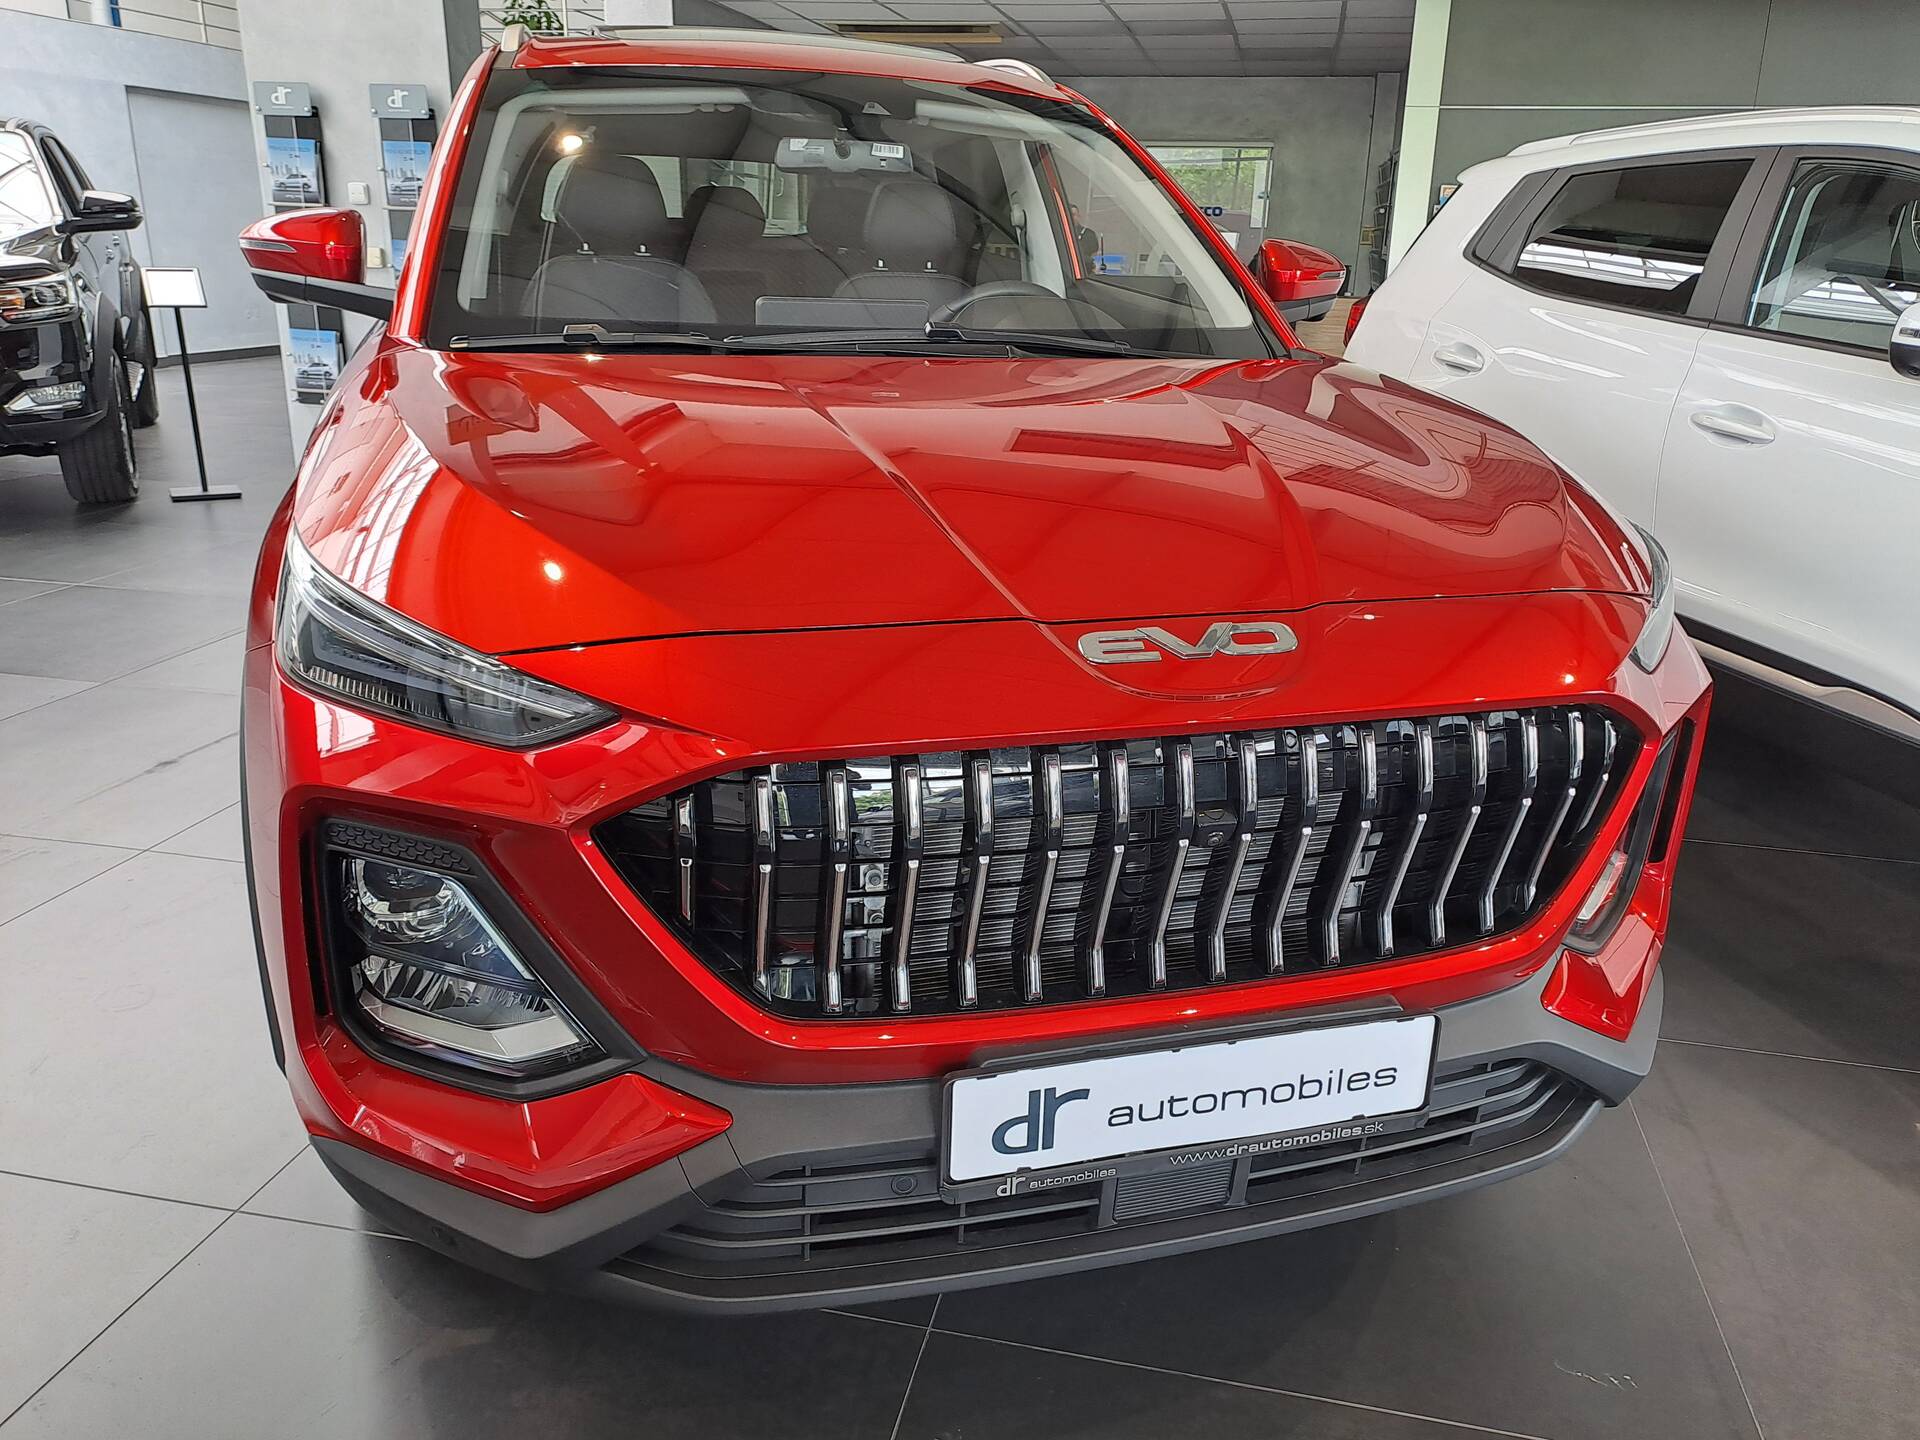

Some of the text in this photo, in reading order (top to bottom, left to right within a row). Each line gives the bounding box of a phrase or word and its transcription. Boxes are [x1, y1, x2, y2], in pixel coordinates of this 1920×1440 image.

[270, 86, 292, 105] dr
[387, 89, 409, 108] dr
[1077, 621, 1299, 666] EVO
[991, 1066, 1398, 1154] dr automobiles
[1169, 1121, 1384, 1166] www.drautomobiles.sk
[996, 1168, 1117, 1197] dr automobiles
